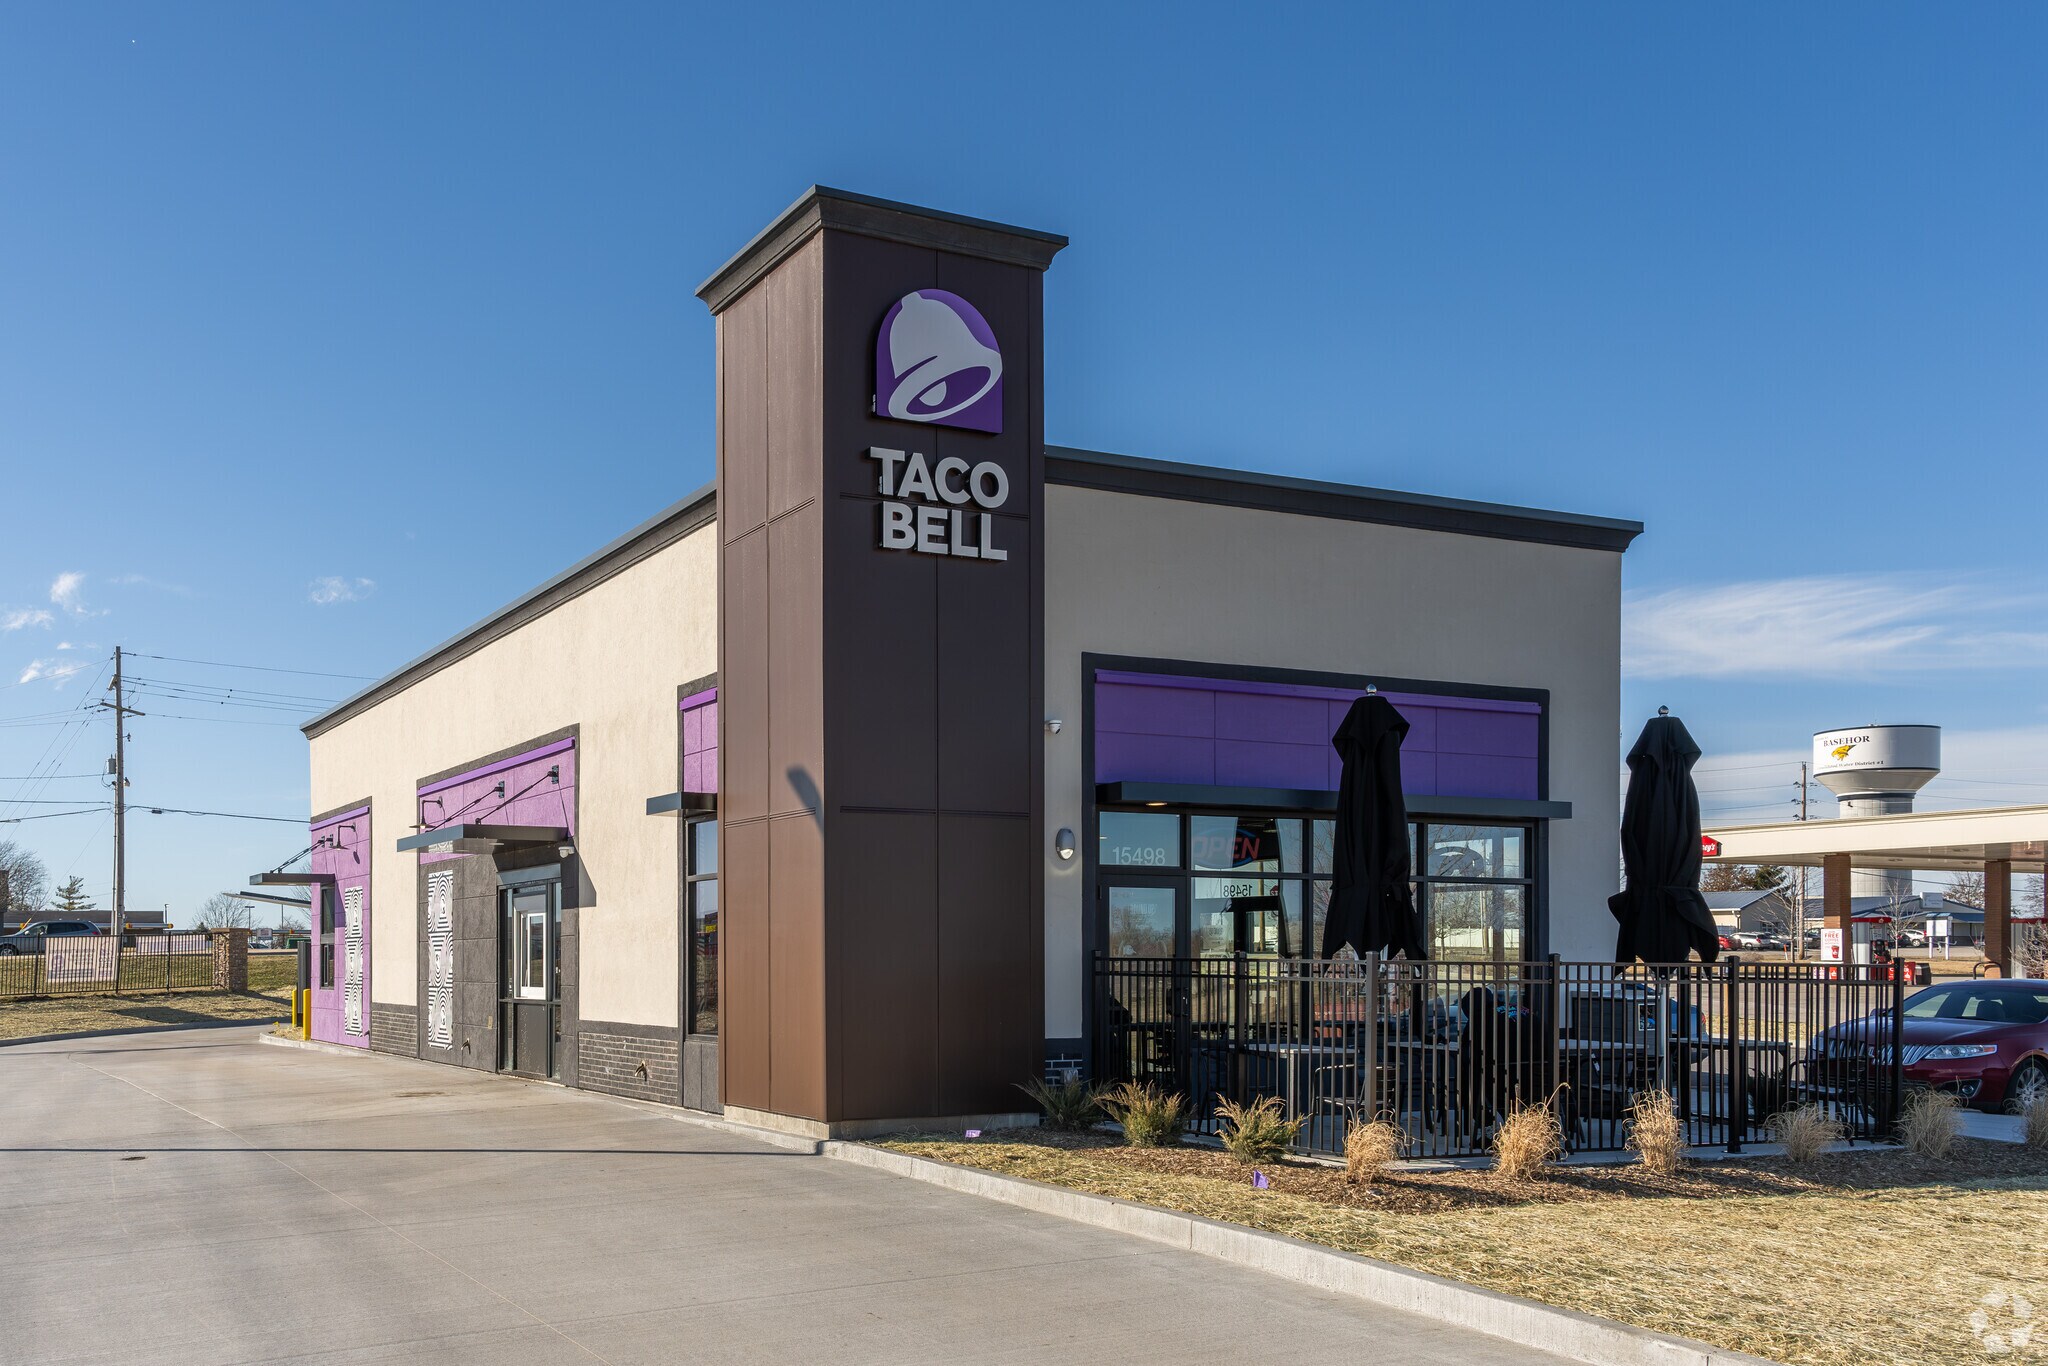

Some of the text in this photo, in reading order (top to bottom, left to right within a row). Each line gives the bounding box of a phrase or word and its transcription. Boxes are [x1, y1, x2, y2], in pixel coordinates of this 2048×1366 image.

[869, 446, 1009, 509] TACO
[881, 501, 1008, 561] BELL
[1824, 736, 1870, 746] BASEHOR
[1112, 846, 1166, 866] 15498
[1193, 836, 1261, 860] OPEN
